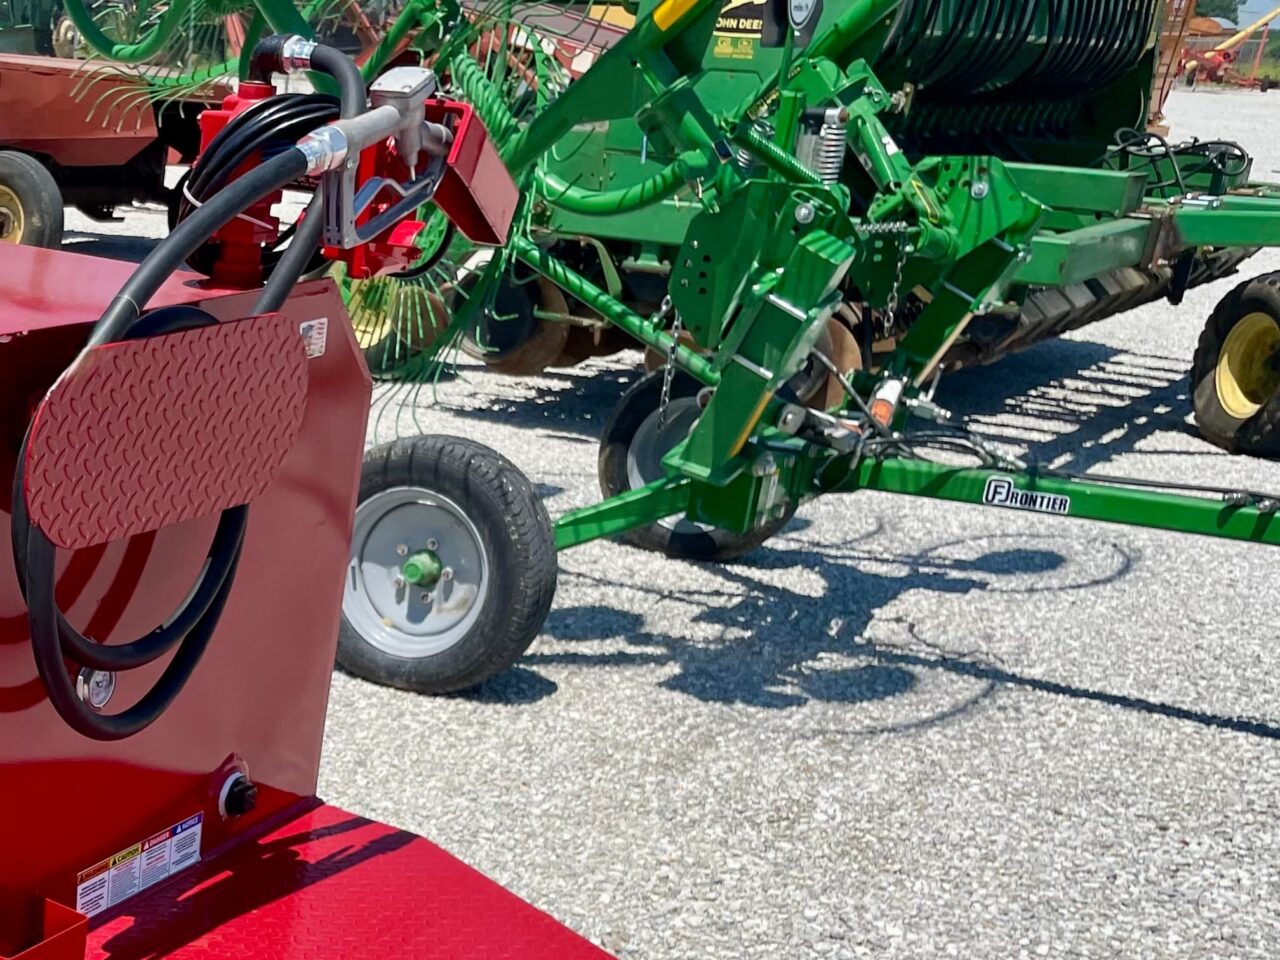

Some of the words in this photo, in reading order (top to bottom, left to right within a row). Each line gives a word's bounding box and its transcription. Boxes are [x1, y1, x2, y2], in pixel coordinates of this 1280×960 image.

[715, 17, 737, 29] OHN
[985, 479, 1068, 511] FRONTIER
[117, 847, 140, 862] CAUTION
